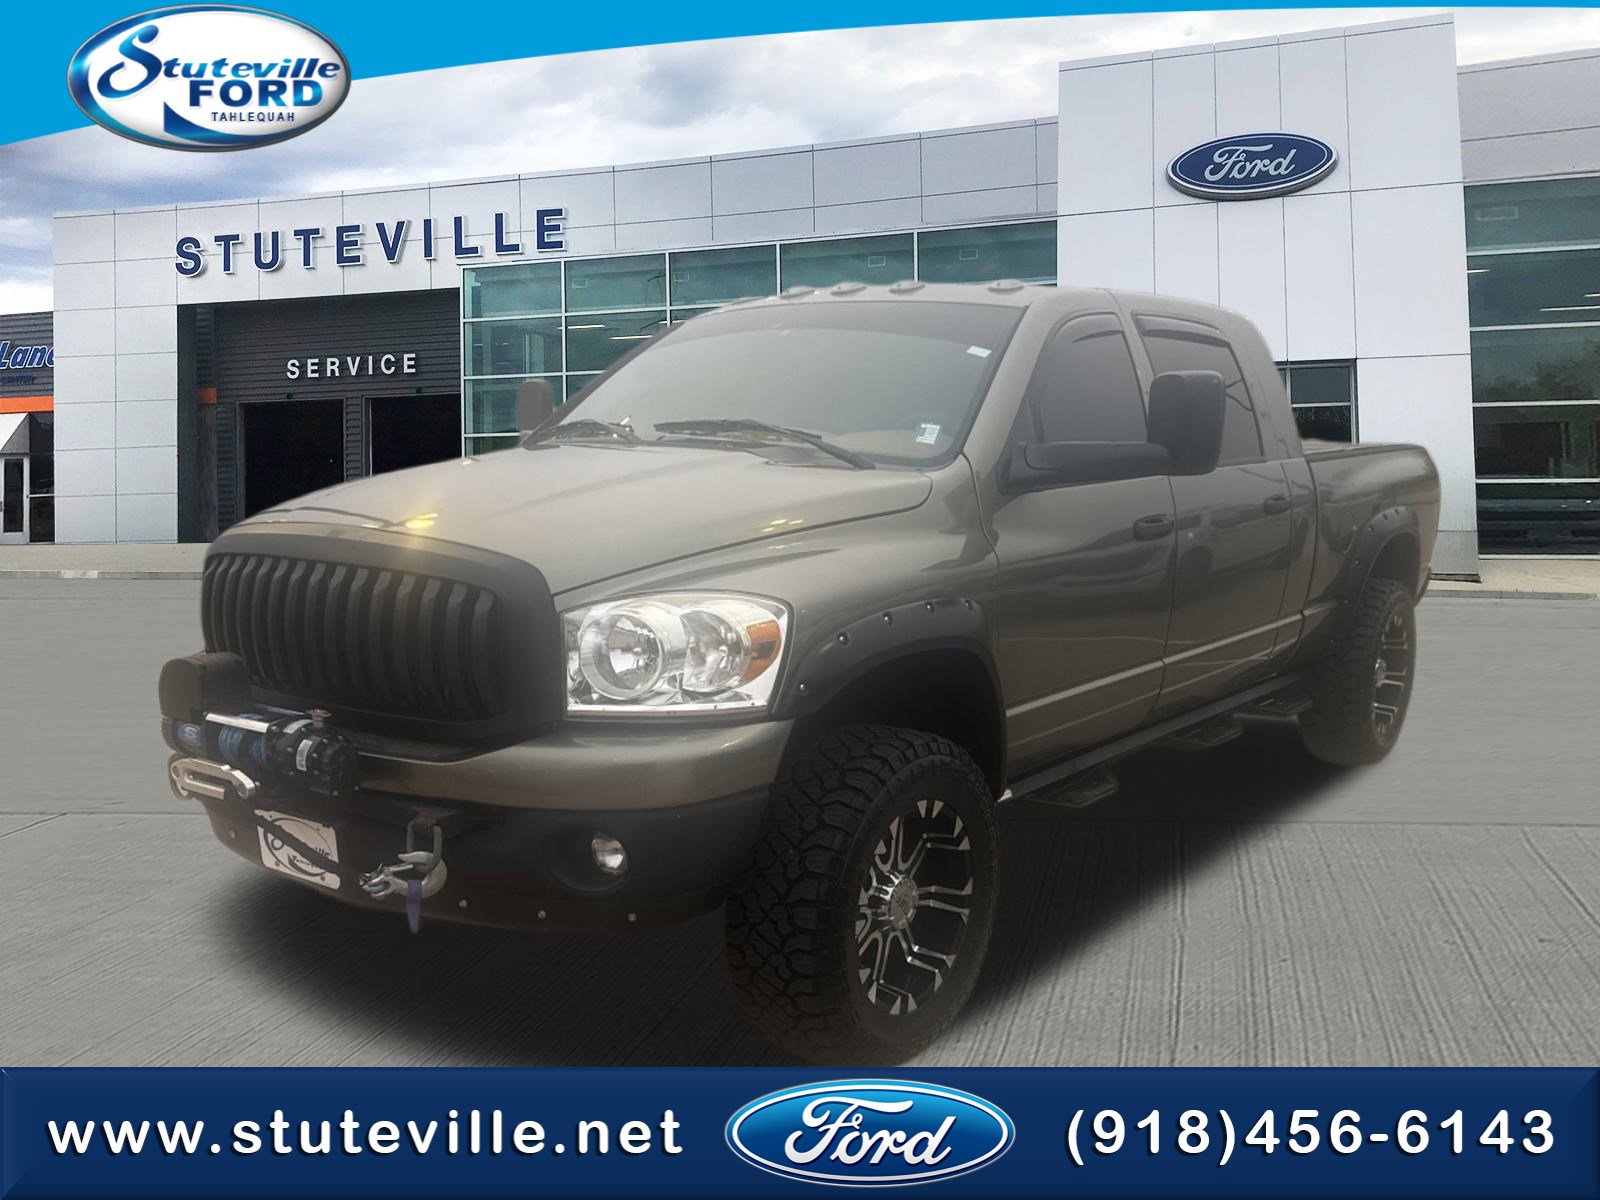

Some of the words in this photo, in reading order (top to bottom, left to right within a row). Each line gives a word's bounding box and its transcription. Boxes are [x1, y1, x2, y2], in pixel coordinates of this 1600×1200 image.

[1204, 143, 1297, 182] Ford
[175, 207, 566, 278] STUTEVILLE
[286, 353, 417, 380] SERVICE
